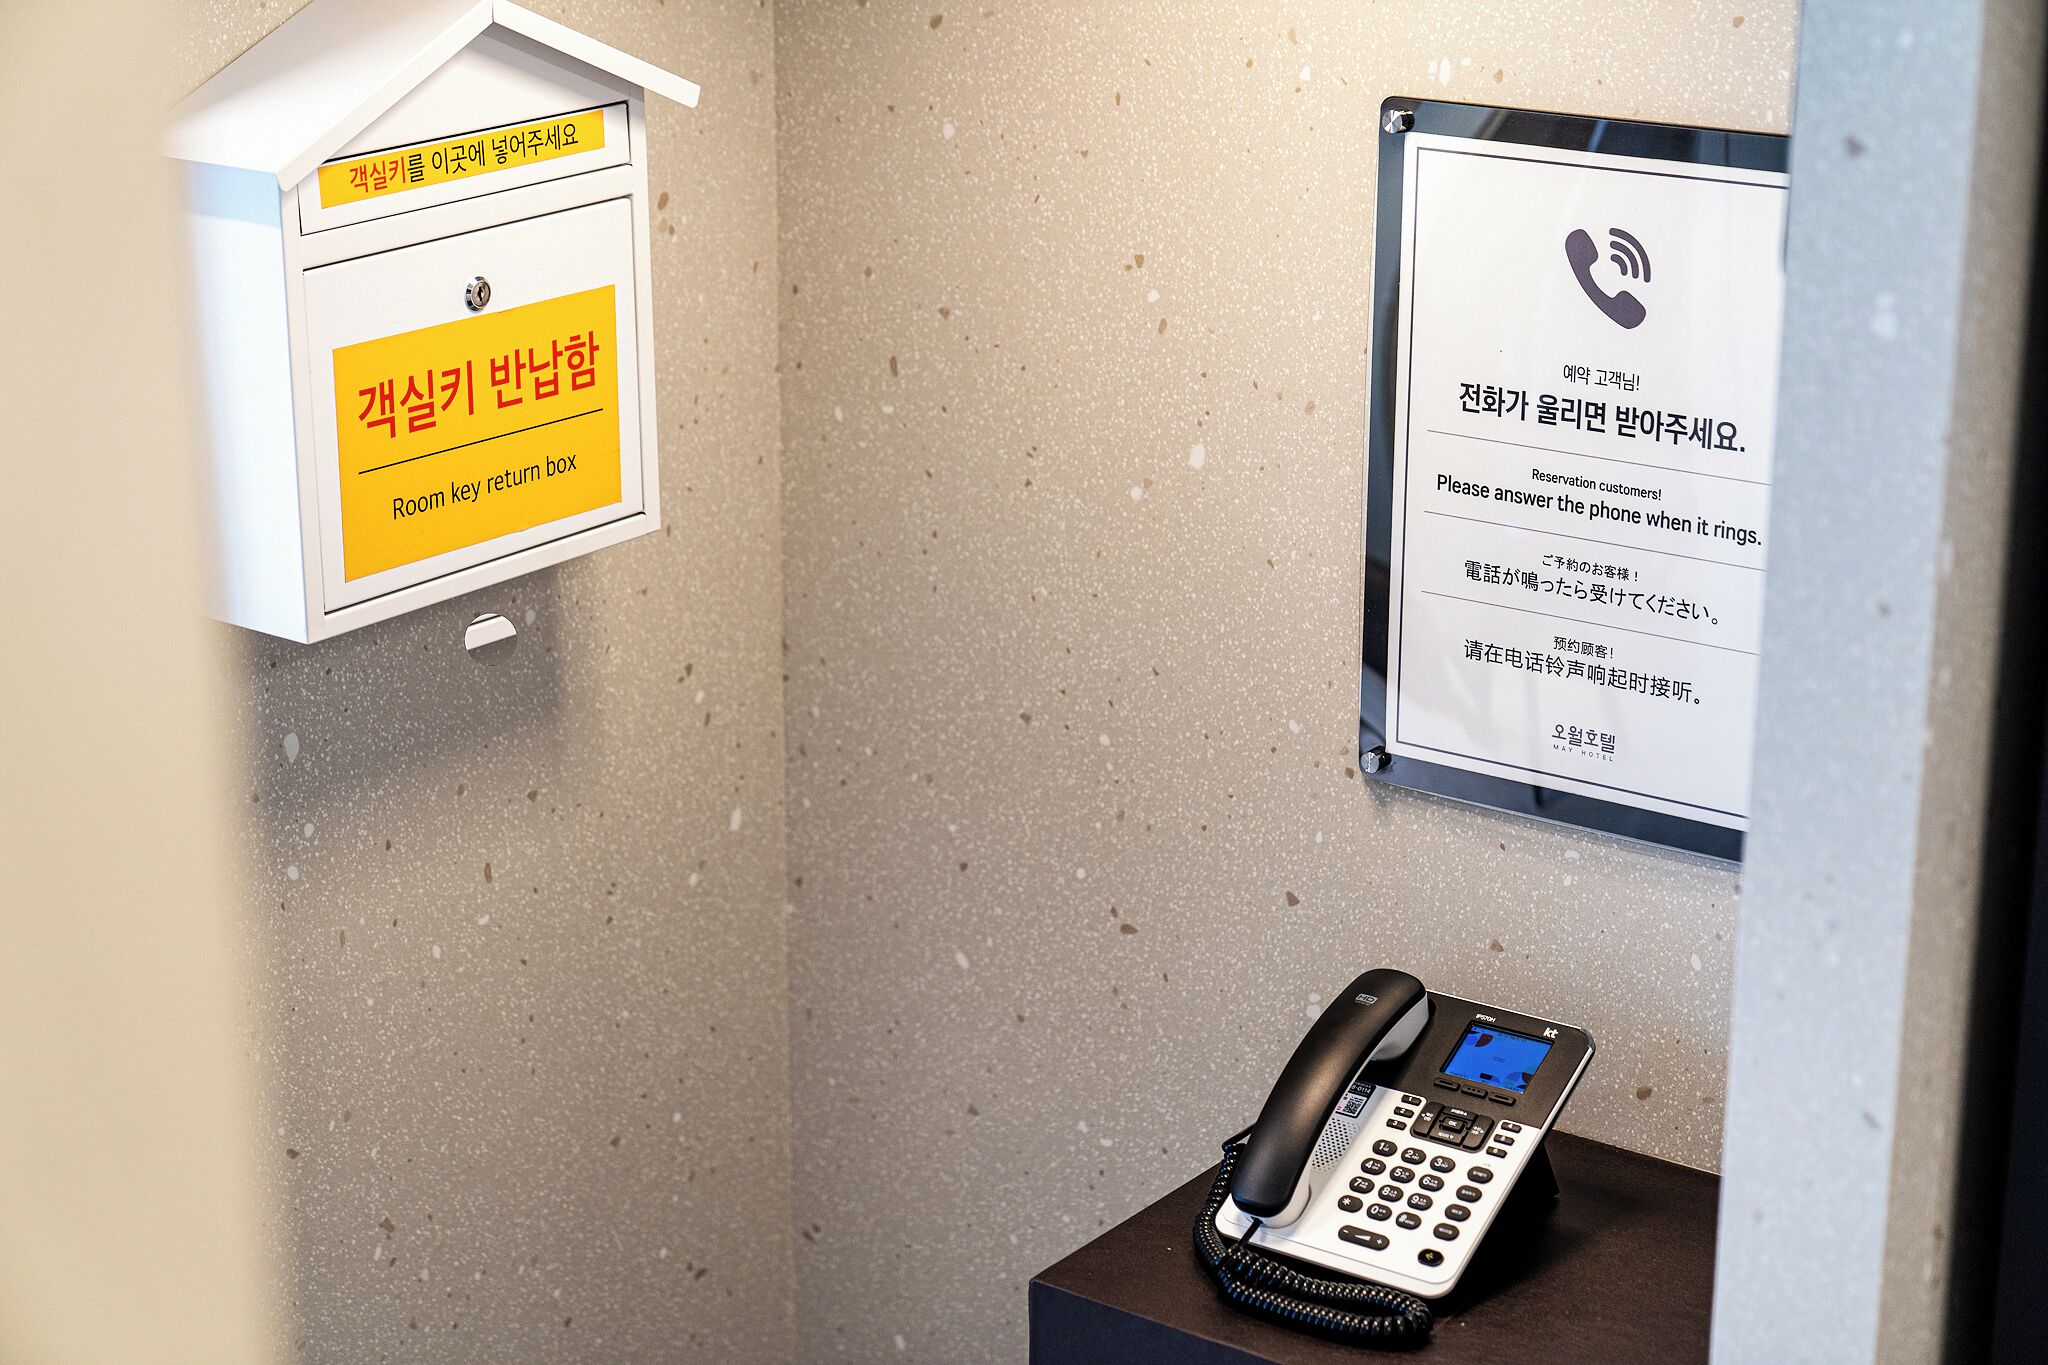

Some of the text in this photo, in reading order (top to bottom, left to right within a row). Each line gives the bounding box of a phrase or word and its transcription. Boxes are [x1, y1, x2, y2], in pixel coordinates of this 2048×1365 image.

[350, 123, 579, 194] 객실키를 이곳에 넣어주세요
[358, 330, 600, 439] 객실키 반납함
[1563, 364, 1640, 391] 예약 고객님!
[1459, 382, 1746, 453] 전화가 울리면 받아주세요.
[393, 453, 577, 520] Room key return box
[1532, 468, 1662, 501] Reservation customers!
[1436, 474, 1762, 546] Please answer the phone when it rings.
[1464, 559, 1719, 626] 電話が鳴ったら受けてください。
[1464, 639, 1700, 705] 请在电话铃声响起时接听。
[1552, 724, 1615, 754] 오월호텔
[1553, 744, 1613, 762] MAY HOTEL
[1357, 994, 1375, 1003] HD
[1543, 1027, 1559, 1039] kt
[1404, 1150, 1413, 1159] 2
[1365, 1160, 1374, 1169] 4
[1434, 1158, 1443, 1167] 3
[1393, 1168, 1402, 1177] 5
[1354, 1178, 1363, 1187] 7
[1422, 1176, 1431, 1185] 6
[1381, 1187, 1390, 1195] 8
[1411, 1195, 1420, 1204] 9
[1370, 1205, 1379, 1214] 0
